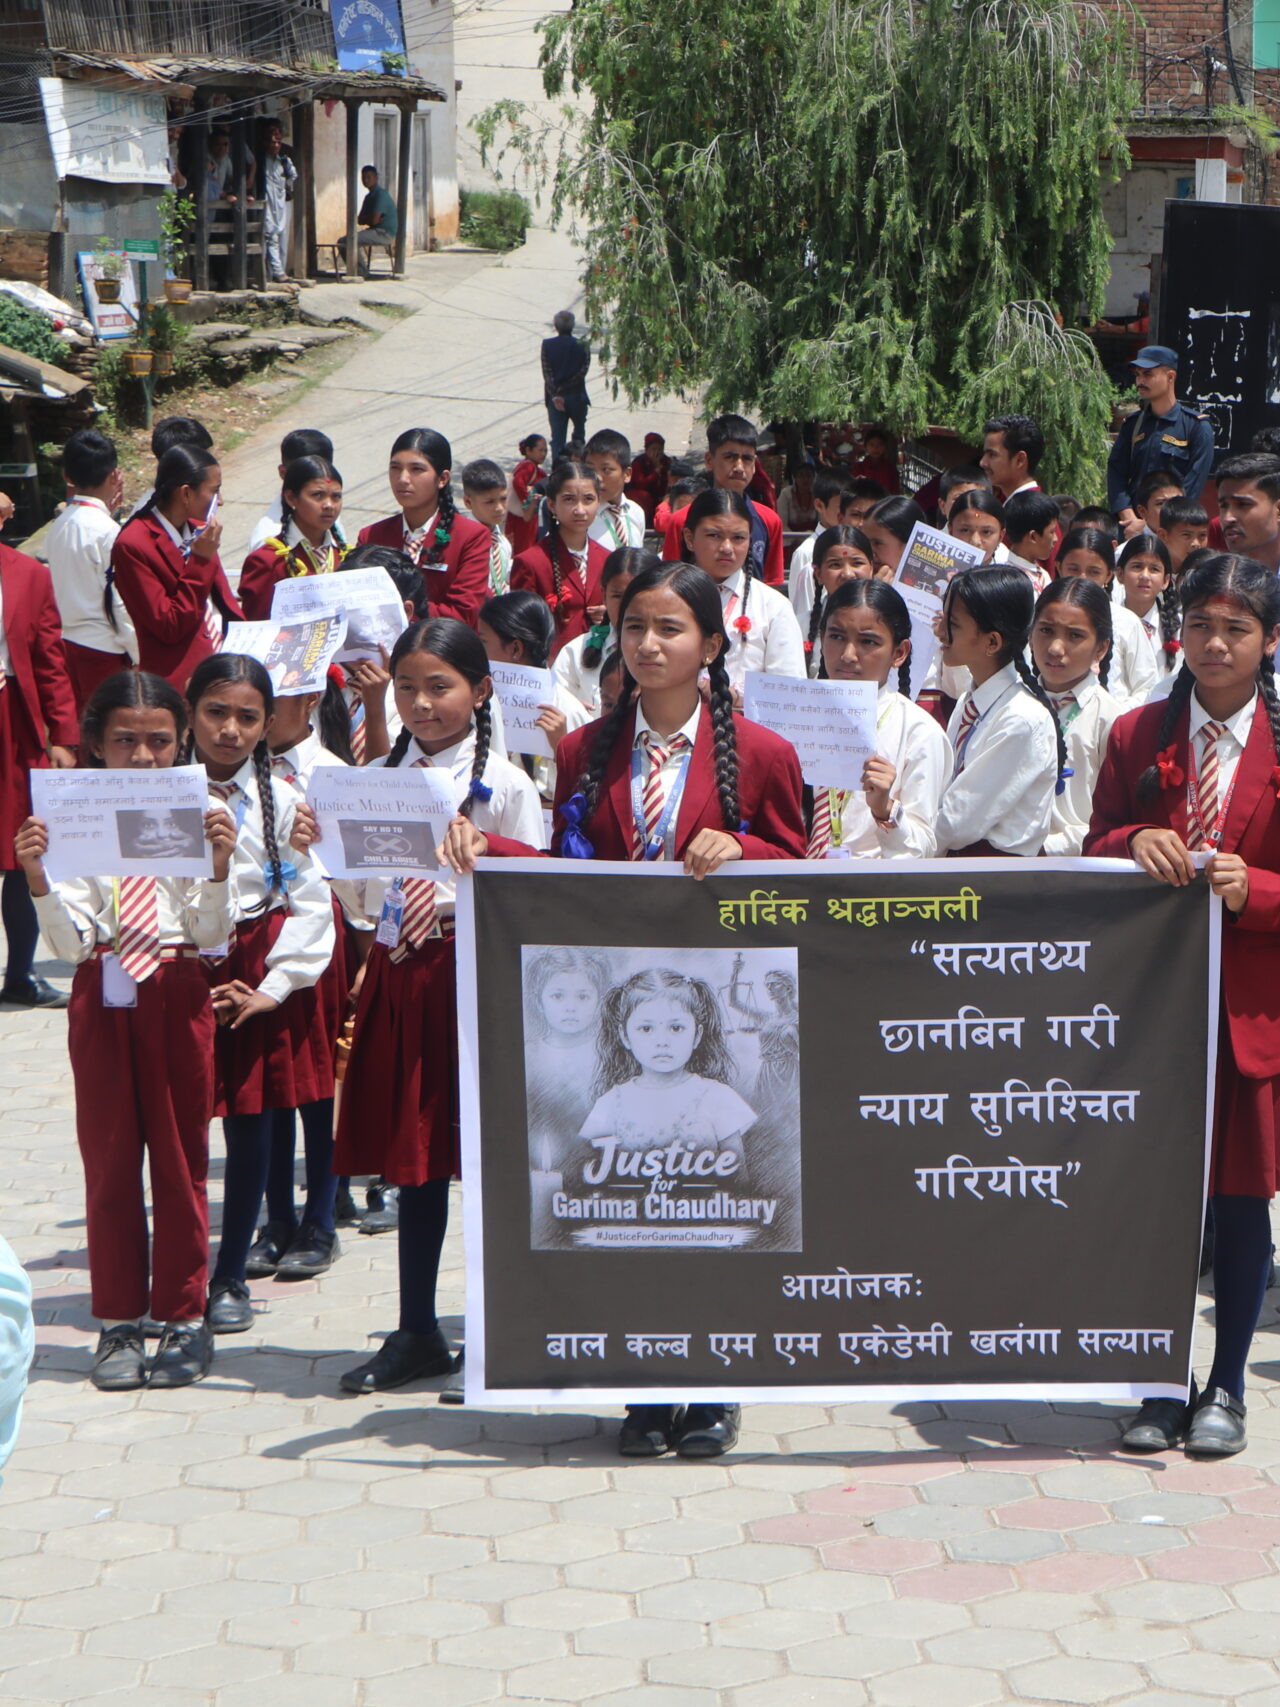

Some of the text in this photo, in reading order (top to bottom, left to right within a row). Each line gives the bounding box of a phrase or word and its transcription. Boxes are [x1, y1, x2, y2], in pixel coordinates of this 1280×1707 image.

[913, 543, 955, 567] GARIMA
[917, 533, 974, 564] JUSTICE
[492, 669, 542, 689] Children
[511, 694, 535, 710] Safe
[312, 797, 355, 812] Justice
[359, 798, 392, 812] Must
[393, 826, 403, 834] TO
[364, 855, 389, 863] CHILD
[392, 856, 419, 864] ABUSE
[719, 887, 982, 931] हार्दिक श्रद्धाञ्जली
[879, 1004, 1120, 1053] छानबिन गरी
[859, 1078, 1141, 1137] न्याय सुनिश्चित
[583, 1136, 740, 1185] Justice
[650, 1174, 677, 1194] for
[552, 1191, 777, 1225] Garima Chaudhary
[596, 1232, 735, 1243] #JusticeForGarimaChaudhary
[547, 1321, 1174, 1366] बाल कल्ब एम एम एकेडेमी खलंगा सल्यान
